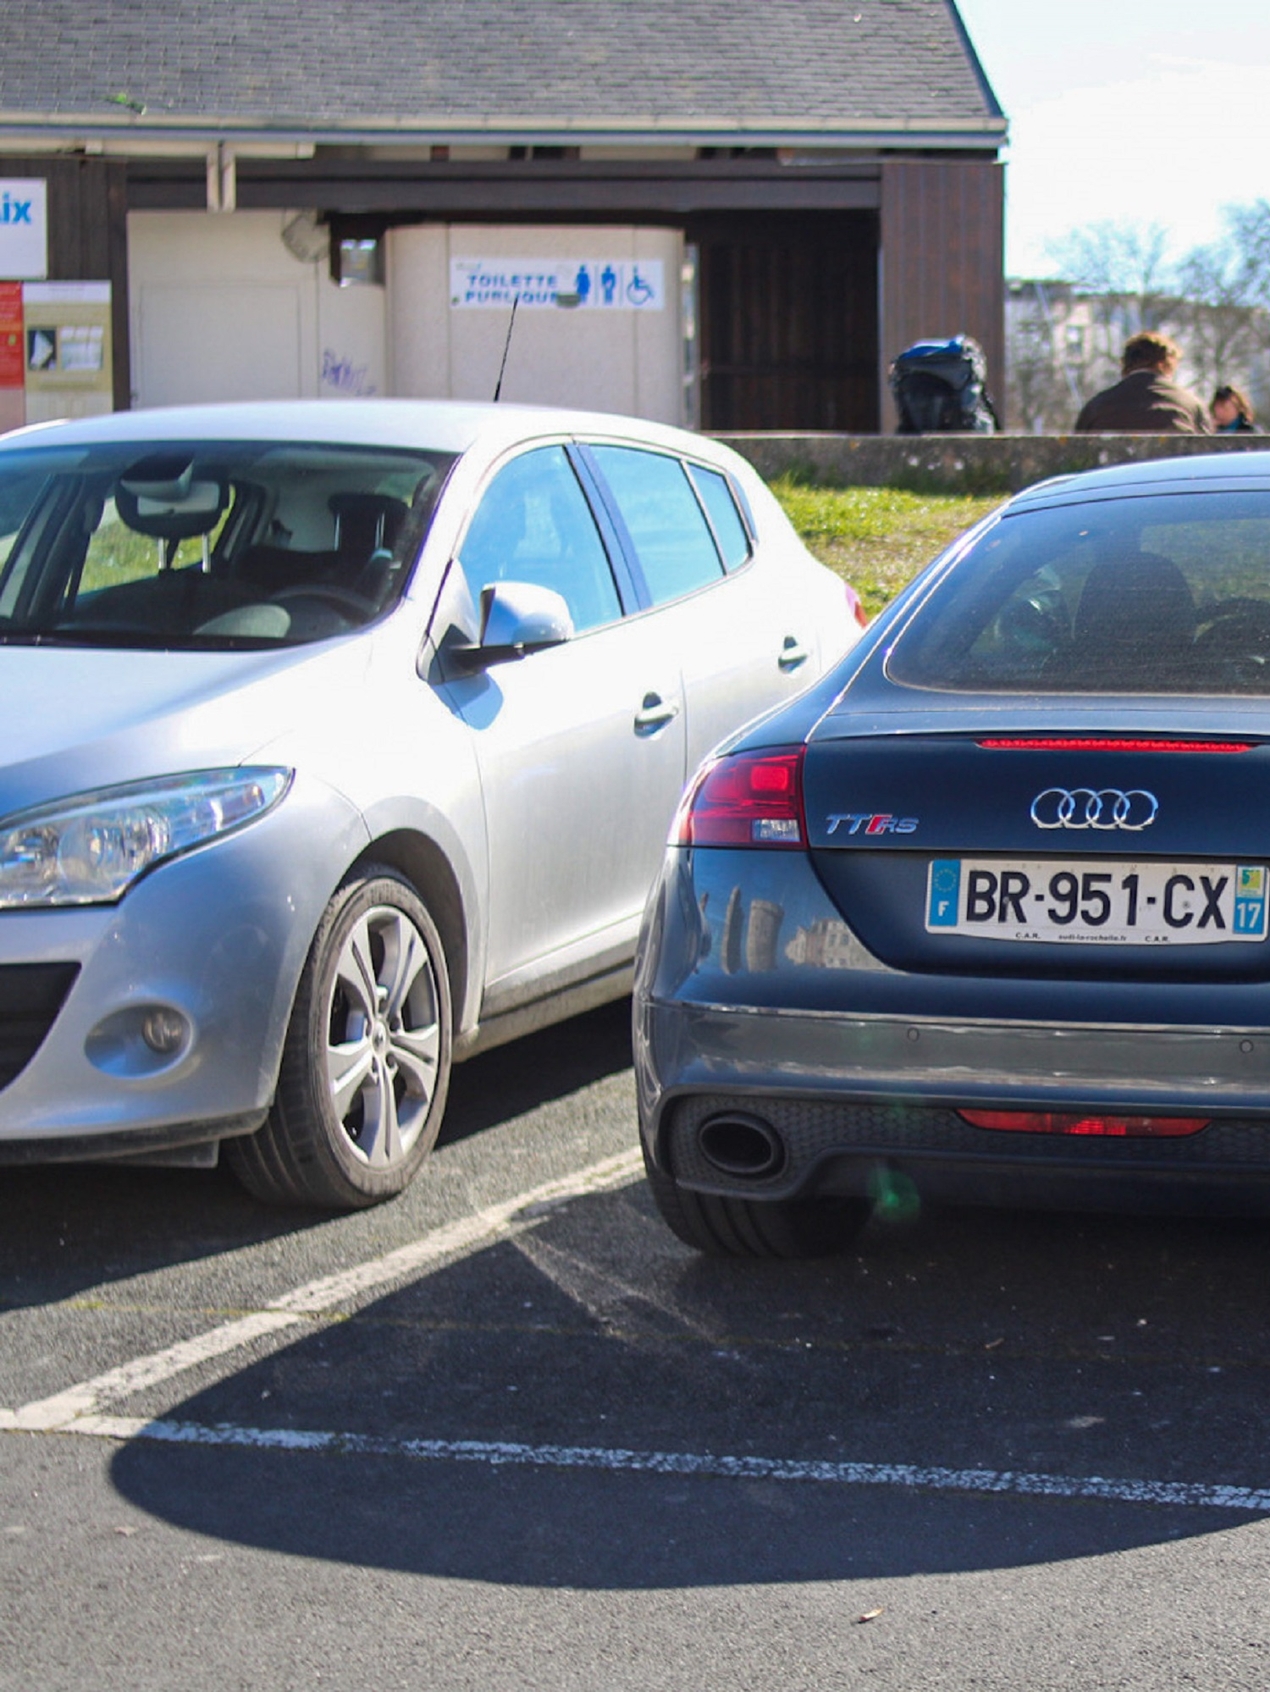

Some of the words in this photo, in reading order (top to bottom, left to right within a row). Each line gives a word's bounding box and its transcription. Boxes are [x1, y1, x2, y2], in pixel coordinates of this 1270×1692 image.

[0, 192, 31, 224] ix
[467, 274, 558, 288] TOILETTE
[938, 901, 949, 916] F
[966, 870, 1228, 929] BR-951-CX
[1237, 902, 1261, 929] 17
